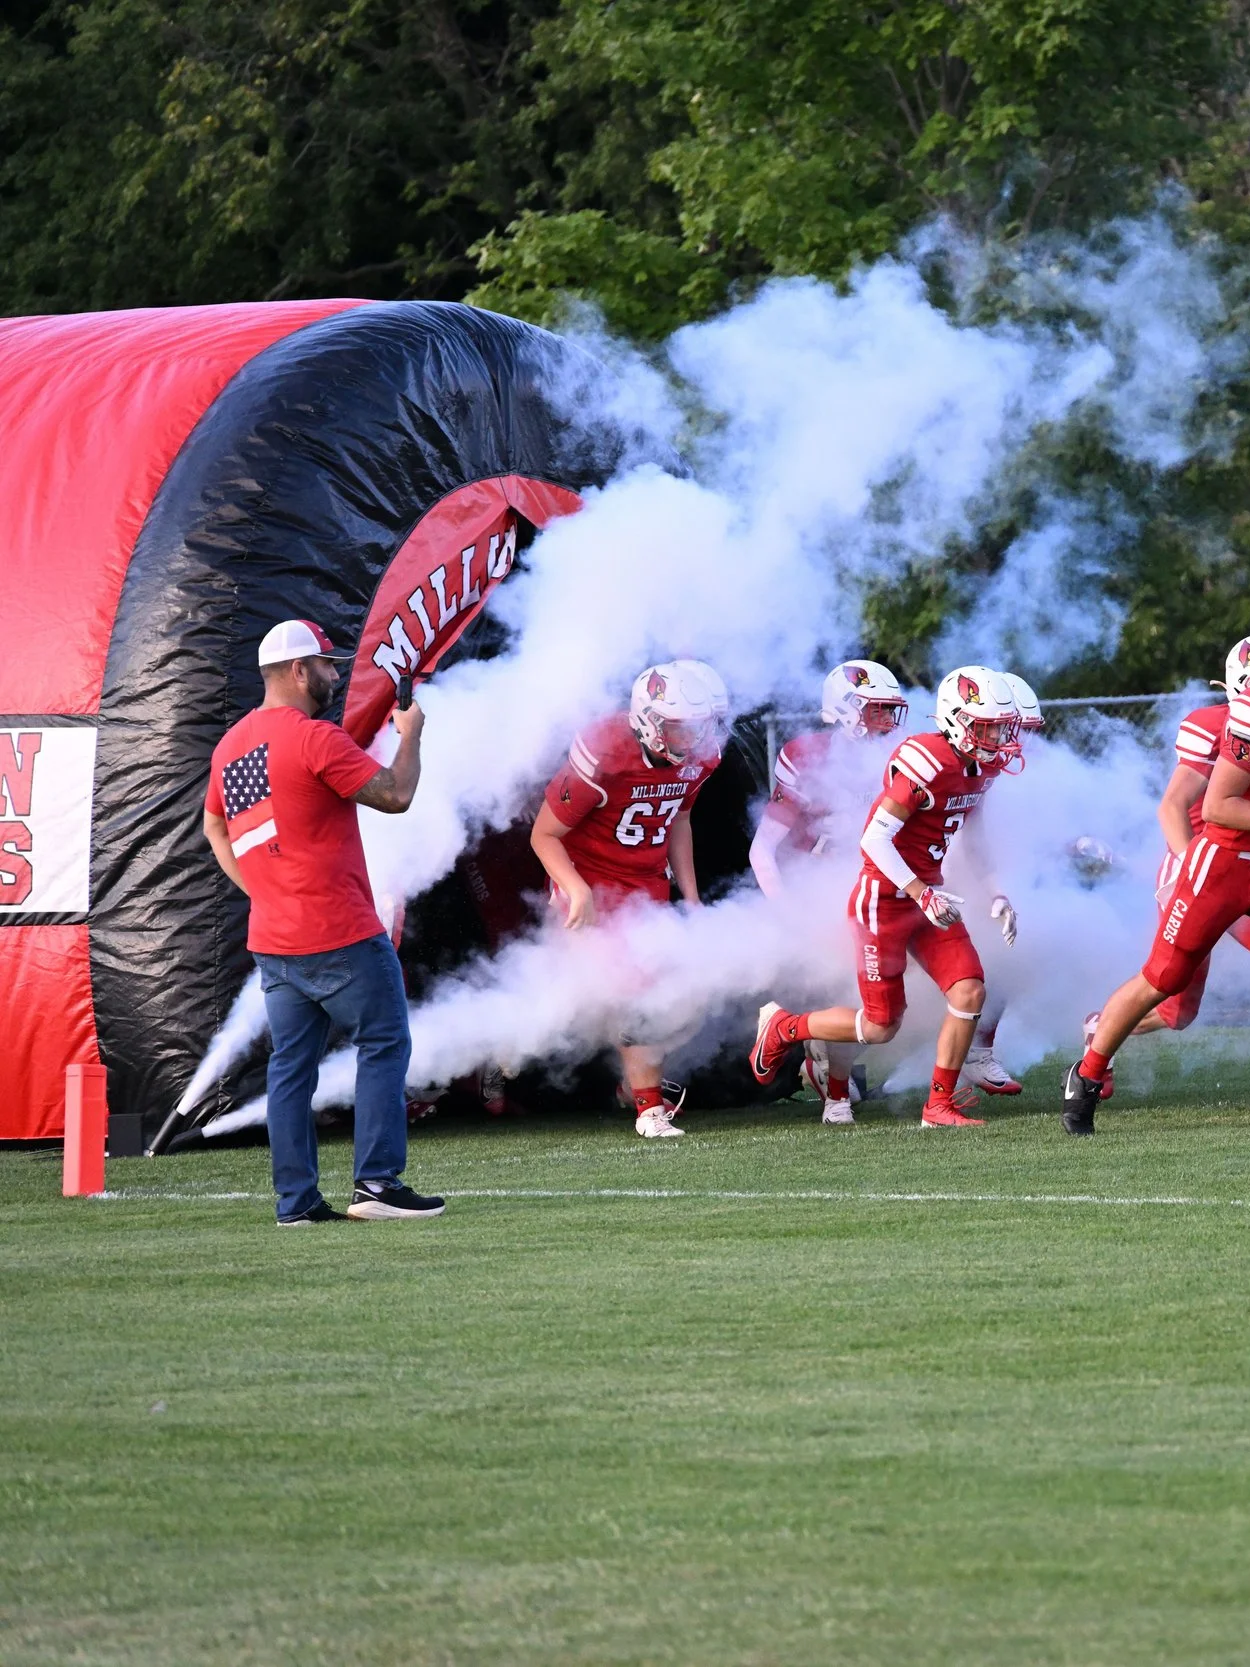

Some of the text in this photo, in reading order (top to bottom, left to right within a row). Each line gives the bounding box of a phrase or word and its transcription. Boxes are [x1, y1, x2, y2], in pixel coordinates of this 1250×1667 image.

[630, 782, 689, 799] MILLINGTON
[615, 798, 684, 846] 67
[1163, 898, 1188, 945] CARDS
[864, 944, 882, 982] CARDS
